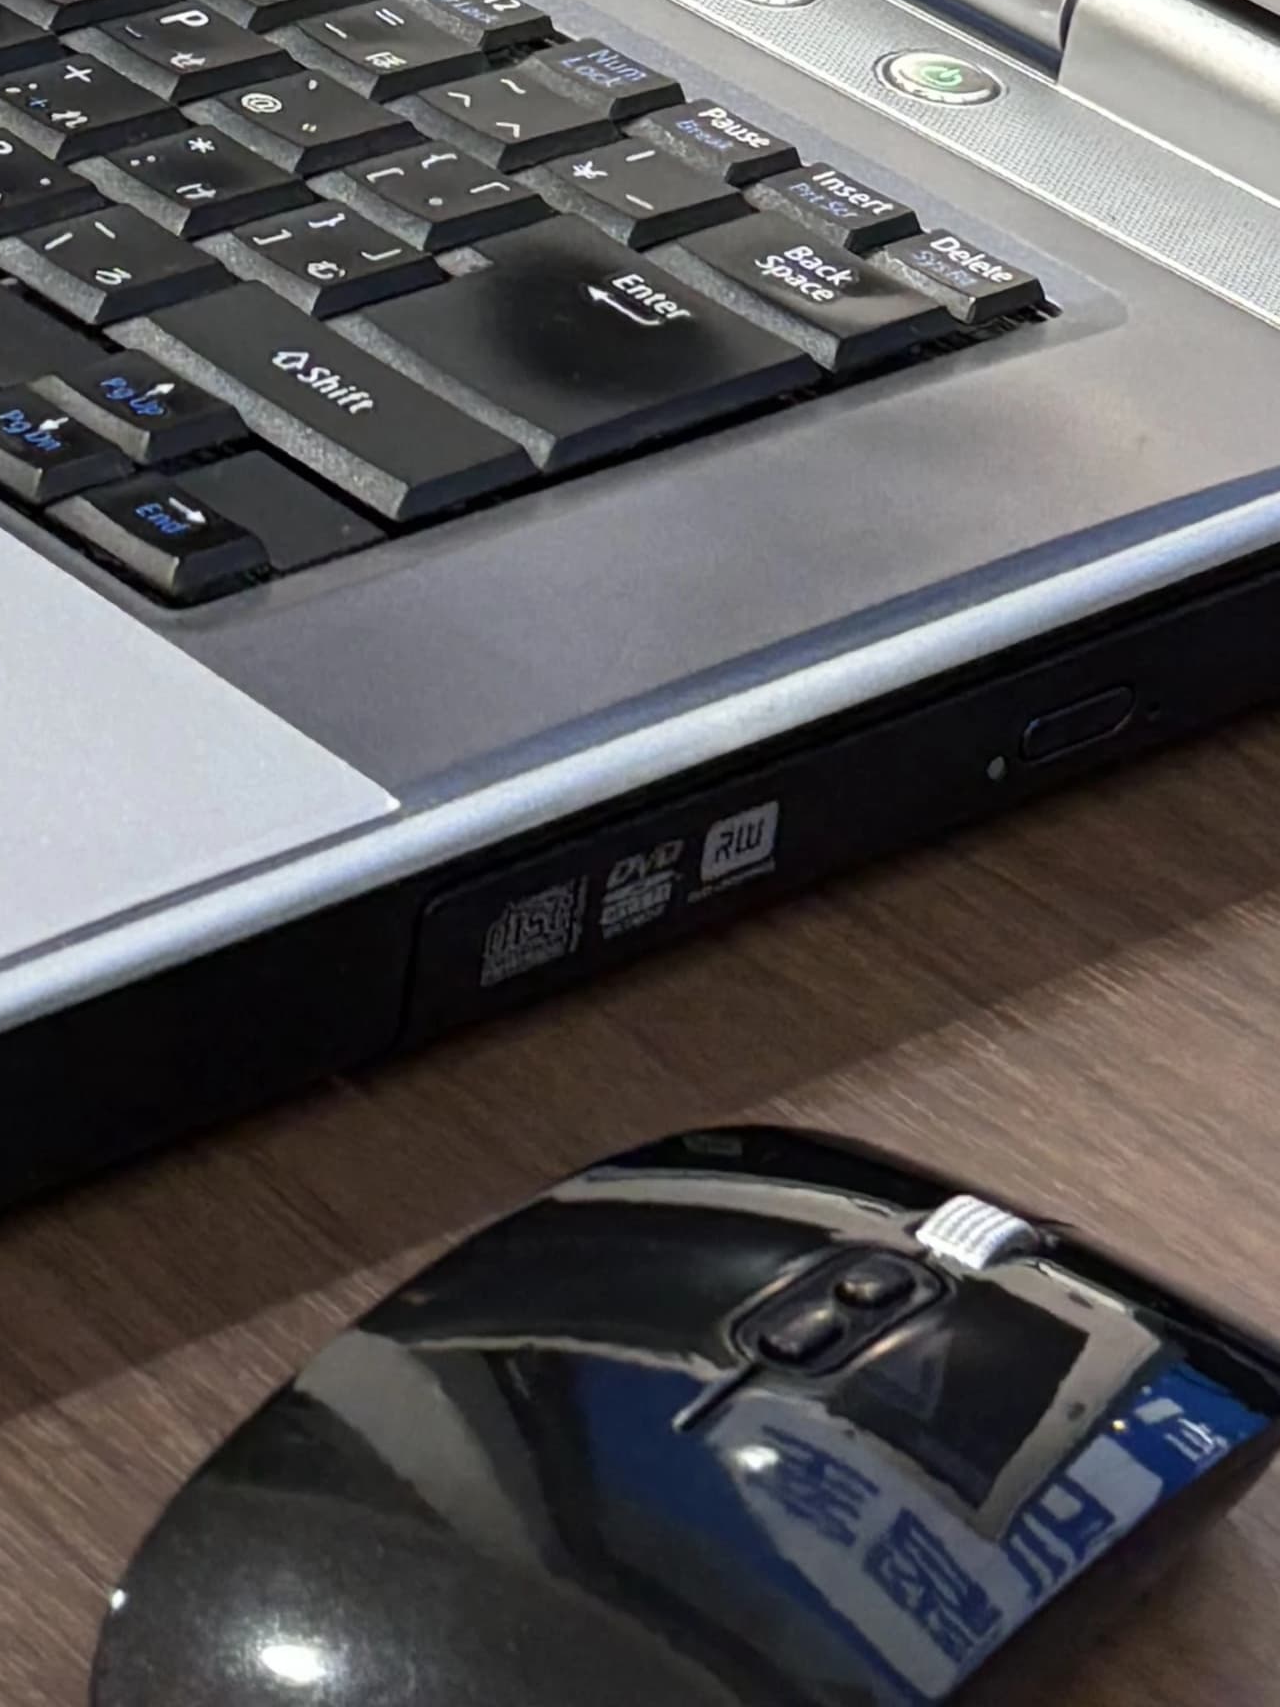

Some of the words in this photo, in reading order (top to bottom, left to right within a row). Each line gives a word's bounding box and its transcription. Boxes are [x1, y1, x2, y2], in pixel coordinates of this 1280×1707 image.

[160, 10, 209, 31] P
[587, 48, 649, 82] Num
[239, 92, 283, 116] @
[697, 106, 771, 150] Pause
[812, 169, 895, 217] Insert
[753, 251, 837, 304] Space
[782, 244, 854, 287] Back
[929, 235, 1015, 285] Delete
[611, 272, 691, 322] Enter
[297, 365, 376, 417] Shift
[134, 501, 189, 535] End
[606, 839, 685, 890] DVD
